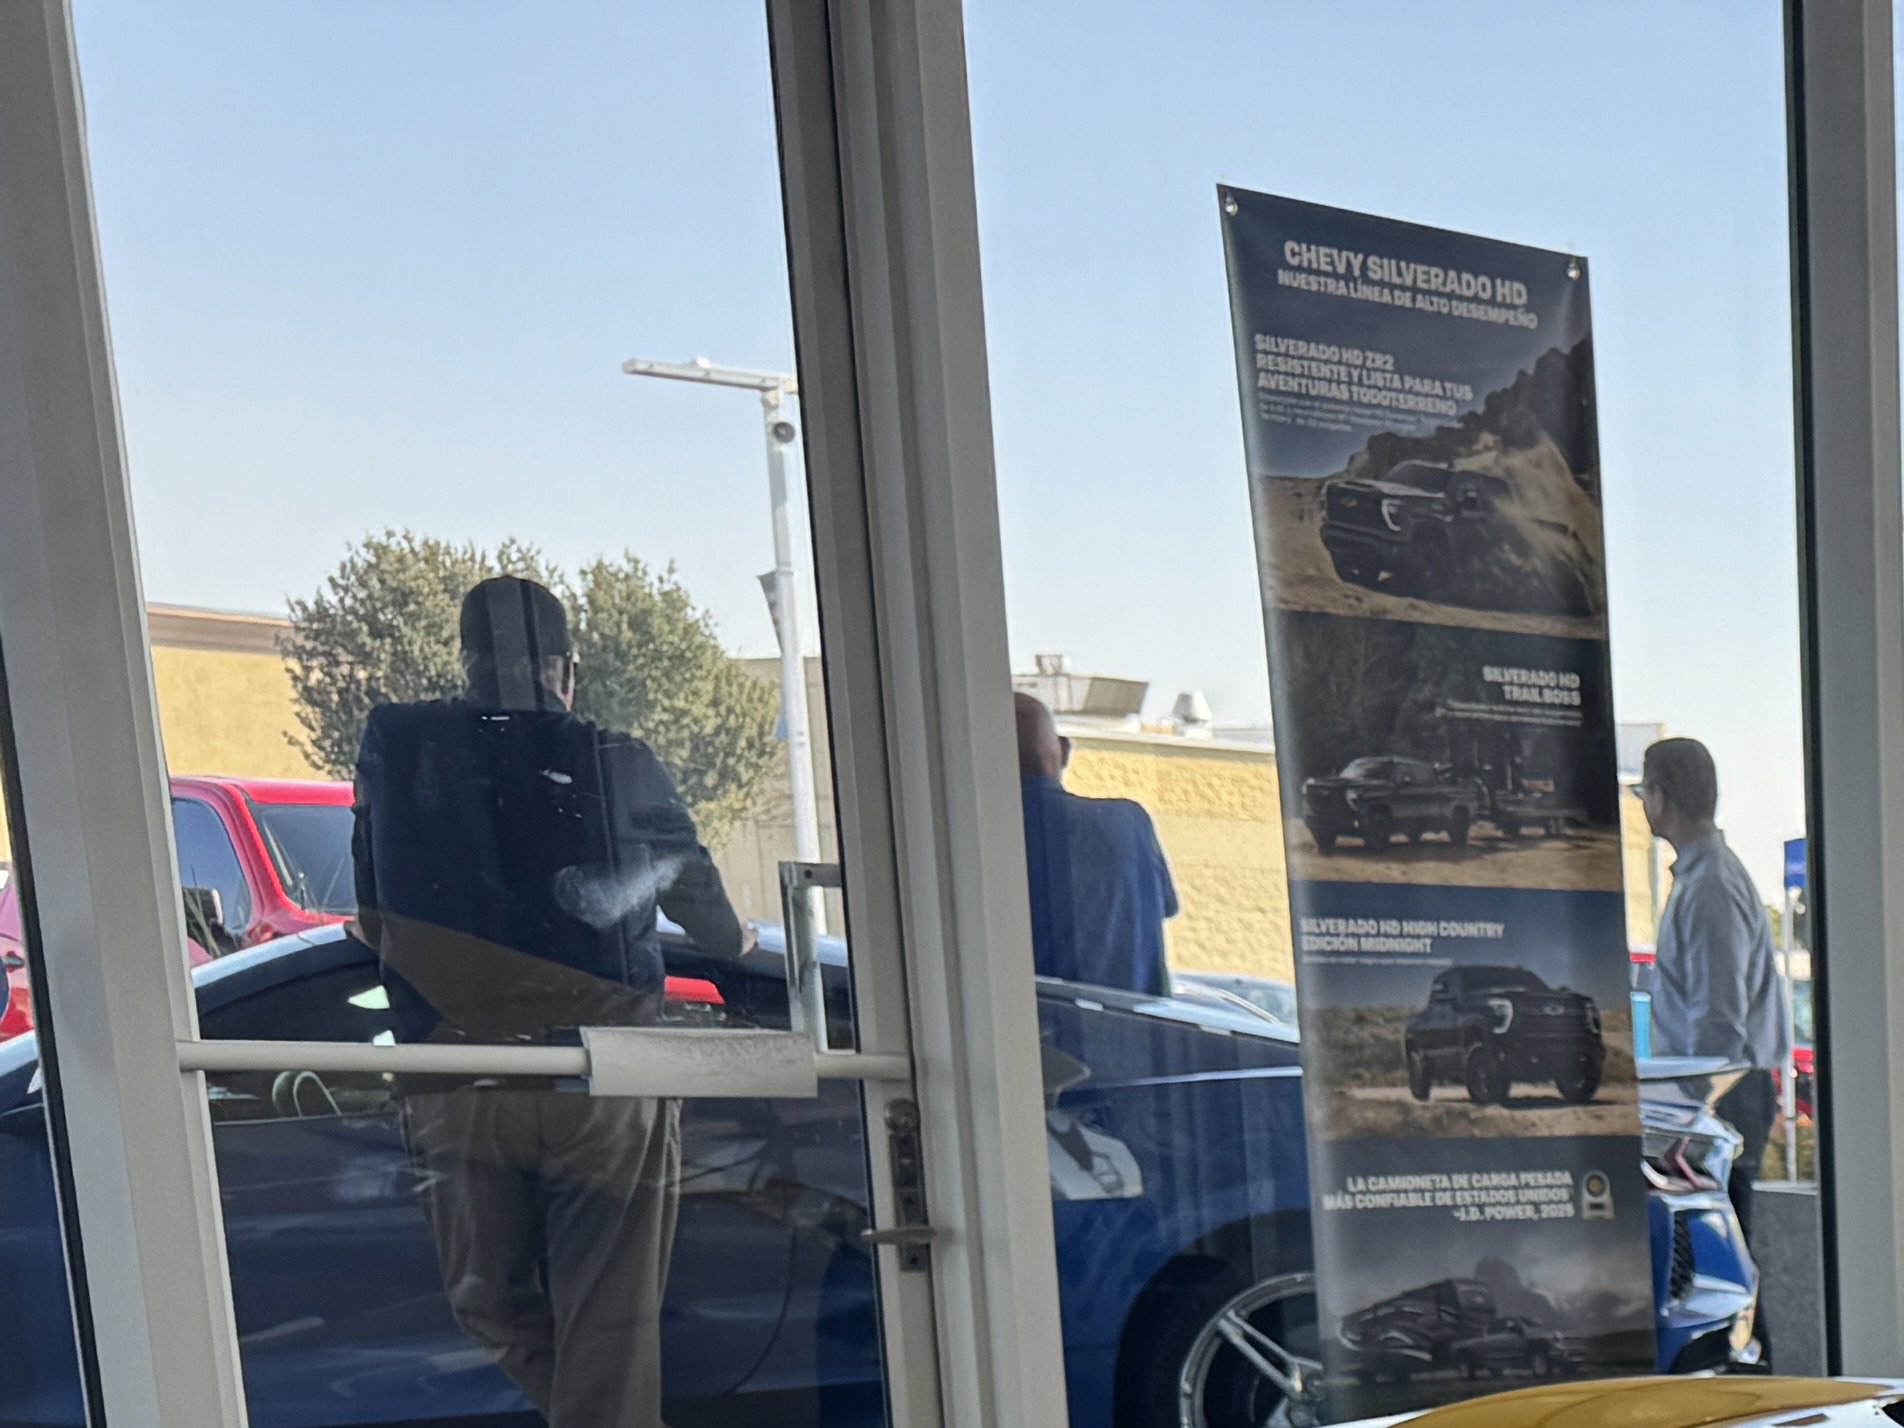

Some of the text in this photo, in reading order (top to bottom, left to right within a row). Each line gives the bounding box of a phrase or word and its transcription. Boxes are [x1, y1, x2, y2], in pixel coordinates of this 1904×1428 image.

[1284, 240, 1528, 305] CHEVY SILVERADO HD
[1278, 269, 1538, 329] NUESTRA LÍNEA DE ALTO DESEMPEÑO
[1255, 334, 1394, 371] SILVERADO HD ZR2
[1256, 354, 1473, 400] RESISTENTE Y LISTA PARA TUS
[1258, 372, 1350, 400] AVENTURAS
[1352, 386, 1457, 416] TODOTERRENO
[1483, 665, 1580, 689] SILVERADO HD
[1300, 916, 1504, 938] SILVERADO HD HIGH COUNTRY
[1360, 936, 1433, 953] MIDNIGHT
[1347, 1170, 1573, 1192] LA CAMIONETA DE CARGA PESADA
[1355, 1189, 1433, 1208] CONFIABLE
[1435, 1190, 1453, 1206] DE
[1455, 1188, 1516, 1206] ESTADOS
